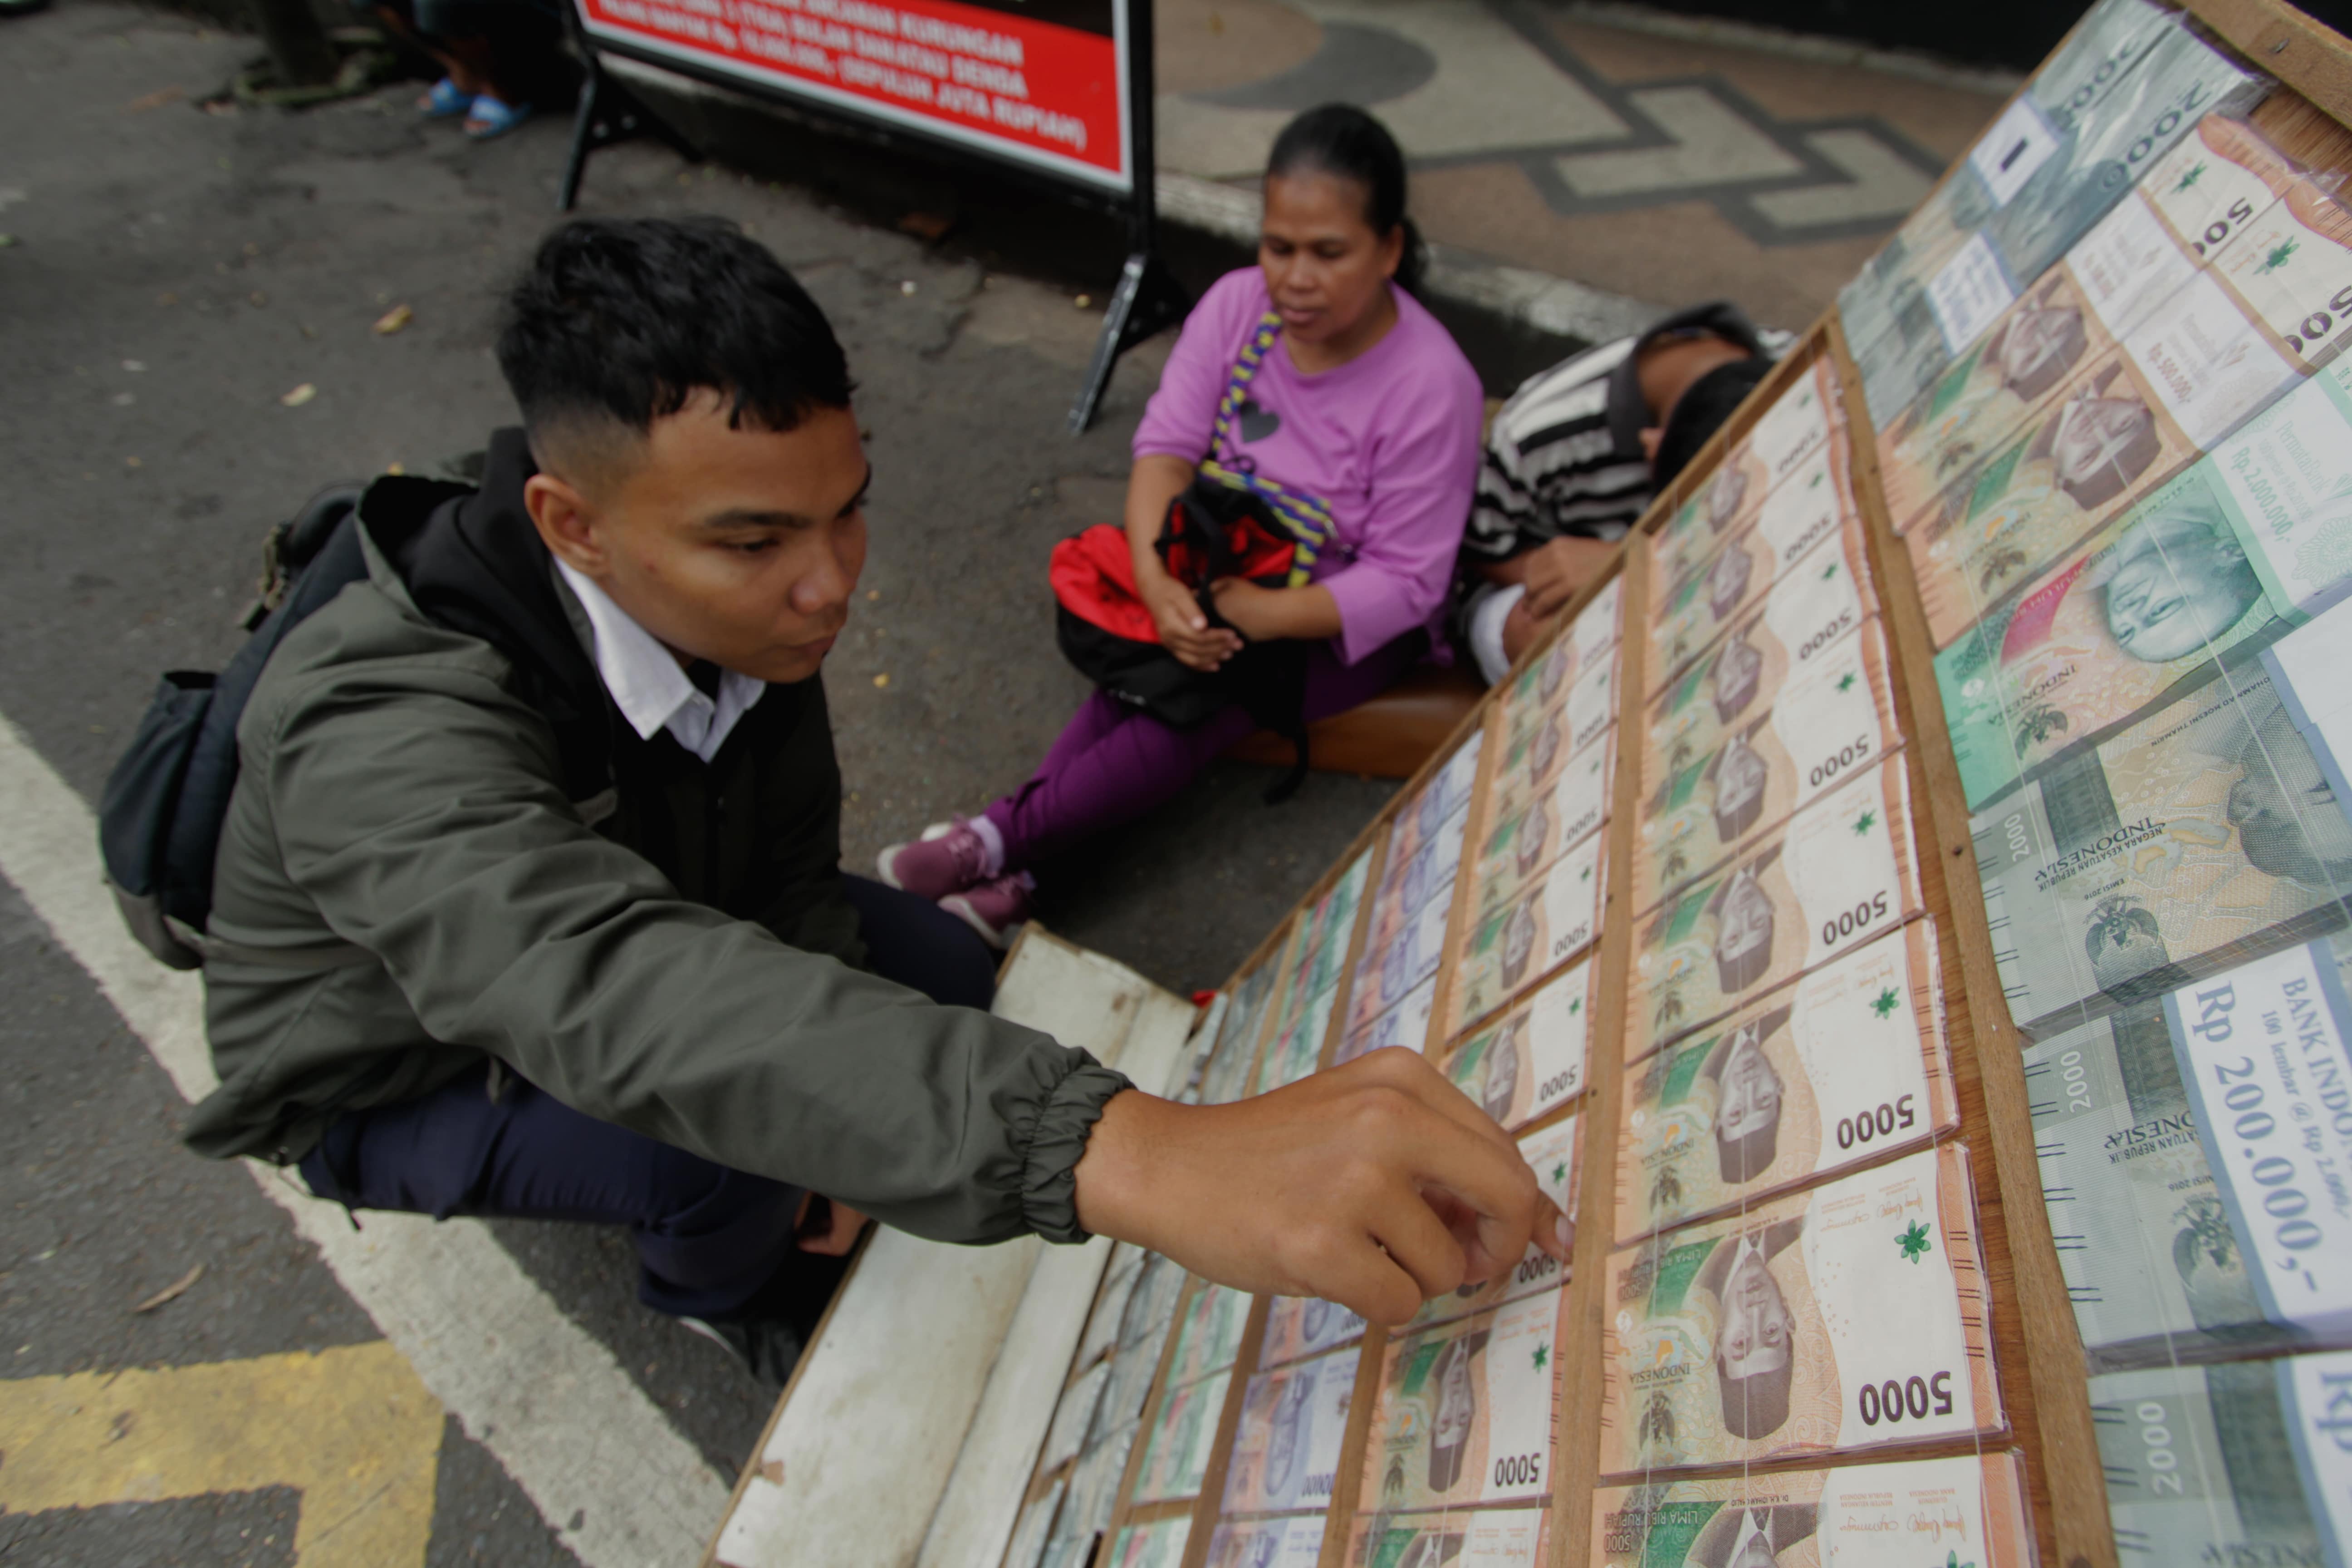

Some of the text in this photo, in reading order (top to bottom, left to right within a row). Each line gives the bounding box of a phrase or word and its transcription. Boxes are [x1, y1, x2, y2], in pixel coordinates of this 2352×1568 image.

[897, 10, 1024, 68] KURUNGAN
[951, 54, 1029, 101] DENDA
[935, 82, 991, 121] JUTA
[992, 94, 1088, 153] RUPIAH)
[2243, 466, 2295, 544] 2.000.000,-
[1799, 606, 1852, 661] 5000
[1988, 664, 2077, 726] INDONESIA
[2189, 704, 2222, 726] HOESNI
[1810, 733, 1870, 788] 5000
[2151, 723, 2188, 747] THAMRIN
[2004, 813, 2030, 862] 2000
[2034, 817, 2166, 882] INDONESIA
[2038, 827, 2162, 893] NEGARA KESATUAN REPUBLIK
[2084, 877, 2125, 901] EMISI 2016
[1554, 922, 1588, 957] 5000
[1823, 890, 1887, 946] 5000
[2261, 1010, 2283, 1035] 100
[1539, 1064, 1578, 1102] 5000
[2060, 1050, 2092, 1114] 2000
[2271, 1041, 2300, 1096] lembar
[2282, 976, 2352, 1162] BANK INDO
[1837, 1094, 1915, 1150] 5000
[2191, 980, 2323, 1292] Rp 200.000,-
[2168, 1176, 2191, 1192] 2016
[1676, 1249, 1701, 1263] LIMA
[1629, 1363, 1691, 1384] INDONESIA
[1859, 1370, 1953, 1426] 5000
[1495, 1453, 1540, 1488] 5000
[2136, 1401, 2184, 1496] 2000
[1604, 1534, 1631, 1552] 5000
[1669, 1510, 1699, 1525] LIMA
